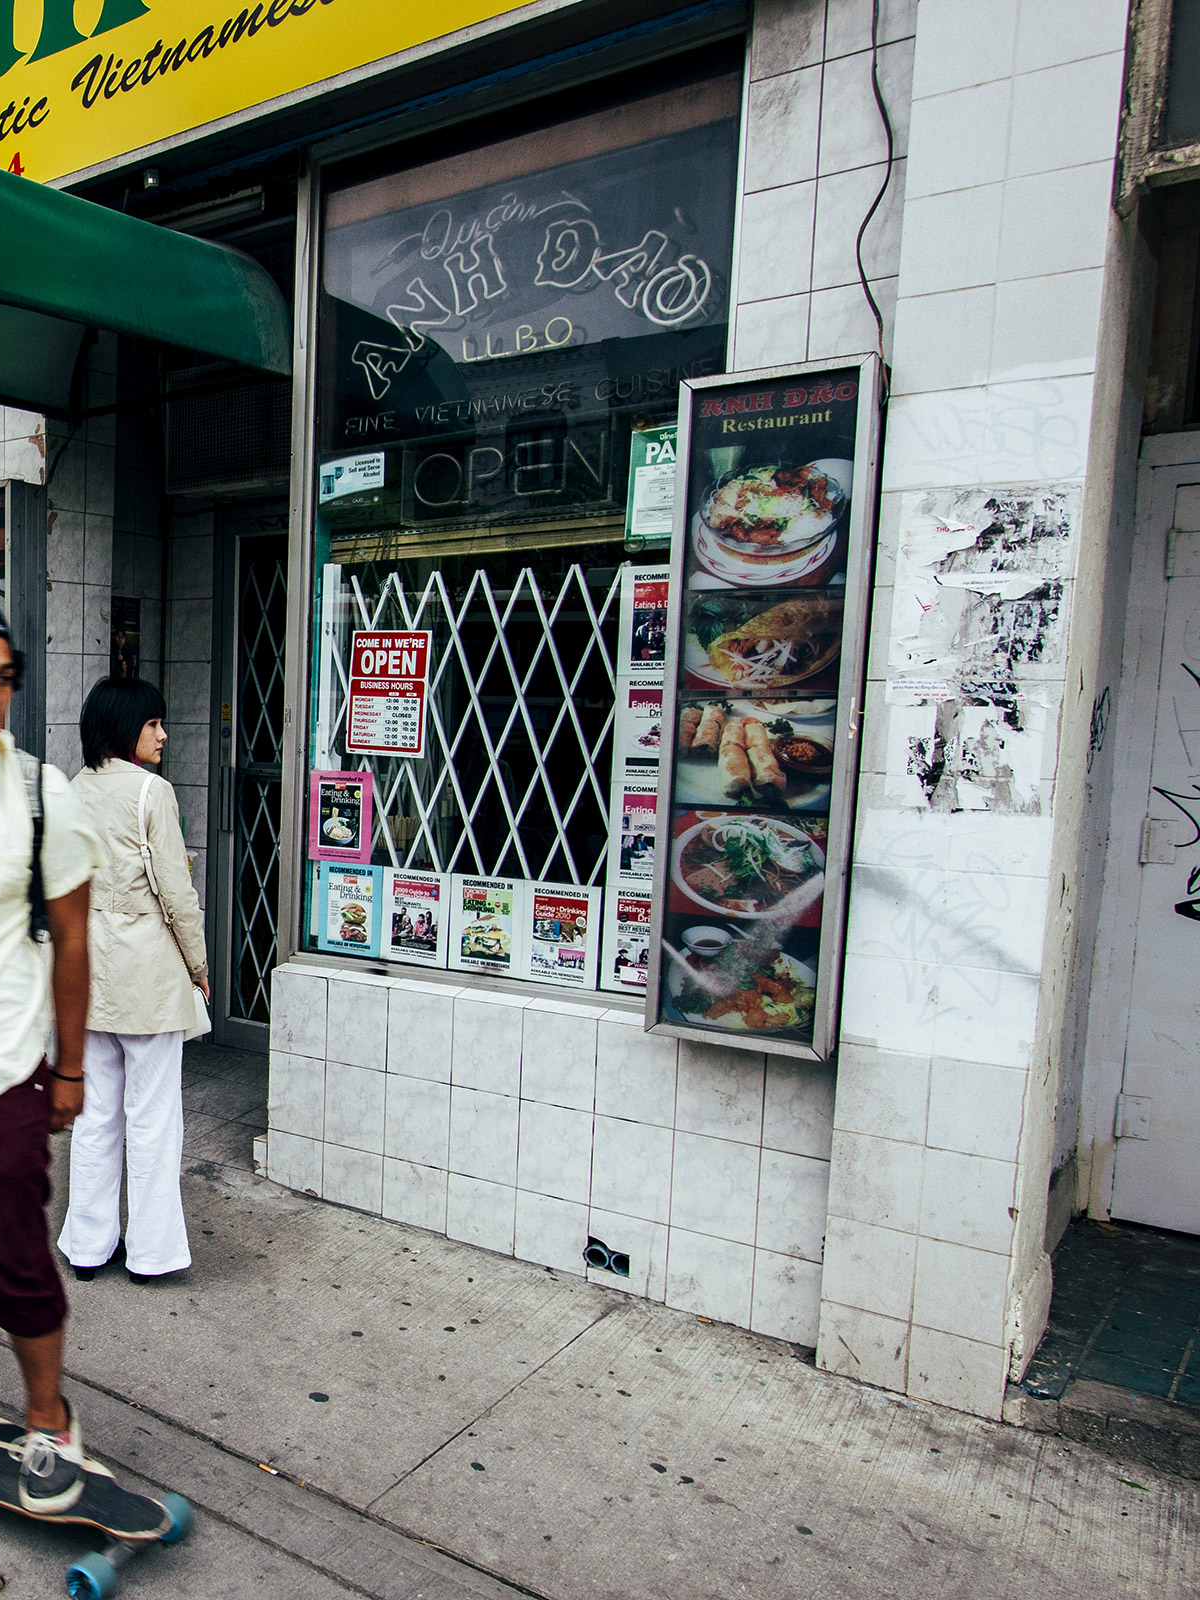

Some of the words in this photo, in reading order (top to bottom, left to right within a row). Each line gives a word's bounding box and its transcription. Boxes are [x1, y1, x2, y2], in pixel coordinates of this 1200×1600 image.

[345, 411, 397, 436] FINE
[415, 381, 575, 424] VIETNAMESE
[722, 408, 832, 434] Restaurant
[646, 440, 677, 465] PA
[355, 458, 376, 467] Licensed
[634, 573, 669, 581] RECOMME
[634, 601, 656, 610] Eating
[356, 638, 379, 649] COME
[382, 638, 392, 649] IN
[395, 638, 425, 649] WE'RE
[361, 650, 417, 676] OPEN
[360, 681, 390, 690] BUSINESS
[390, 682, 414, 691] HOURS
[321, 788, 342, 798] Eating
[343, 789, 349, 797] &
[624, 785, 657, 793] RECOMME
[331, 796, 361, 806] Drinking
[625, 805, 654, 814] Eating
[329, 866, 366, 876] RECOMMENDED
[393, 873, 433, 883] RECOMMENDED
[328, 882, 353, 893] Eating
[354, 885, 361, 893] &
[463, 880, 505, 890] RECOMMENDED
[340, 891, 373, 903] Drinking
[534, 888, 581, 898] RECOMMENDED
[618, 890, 652, 899] RECOMME
[463, 899, 486, 907] EATING
[463, 904, 495, 914] DRINKING
[535, 904, 556, 913] Eating
[559, 906, 586, 916] Drinking
[619, 904, 645, 915] Eating
[555, 912, 571, 920] 2010
